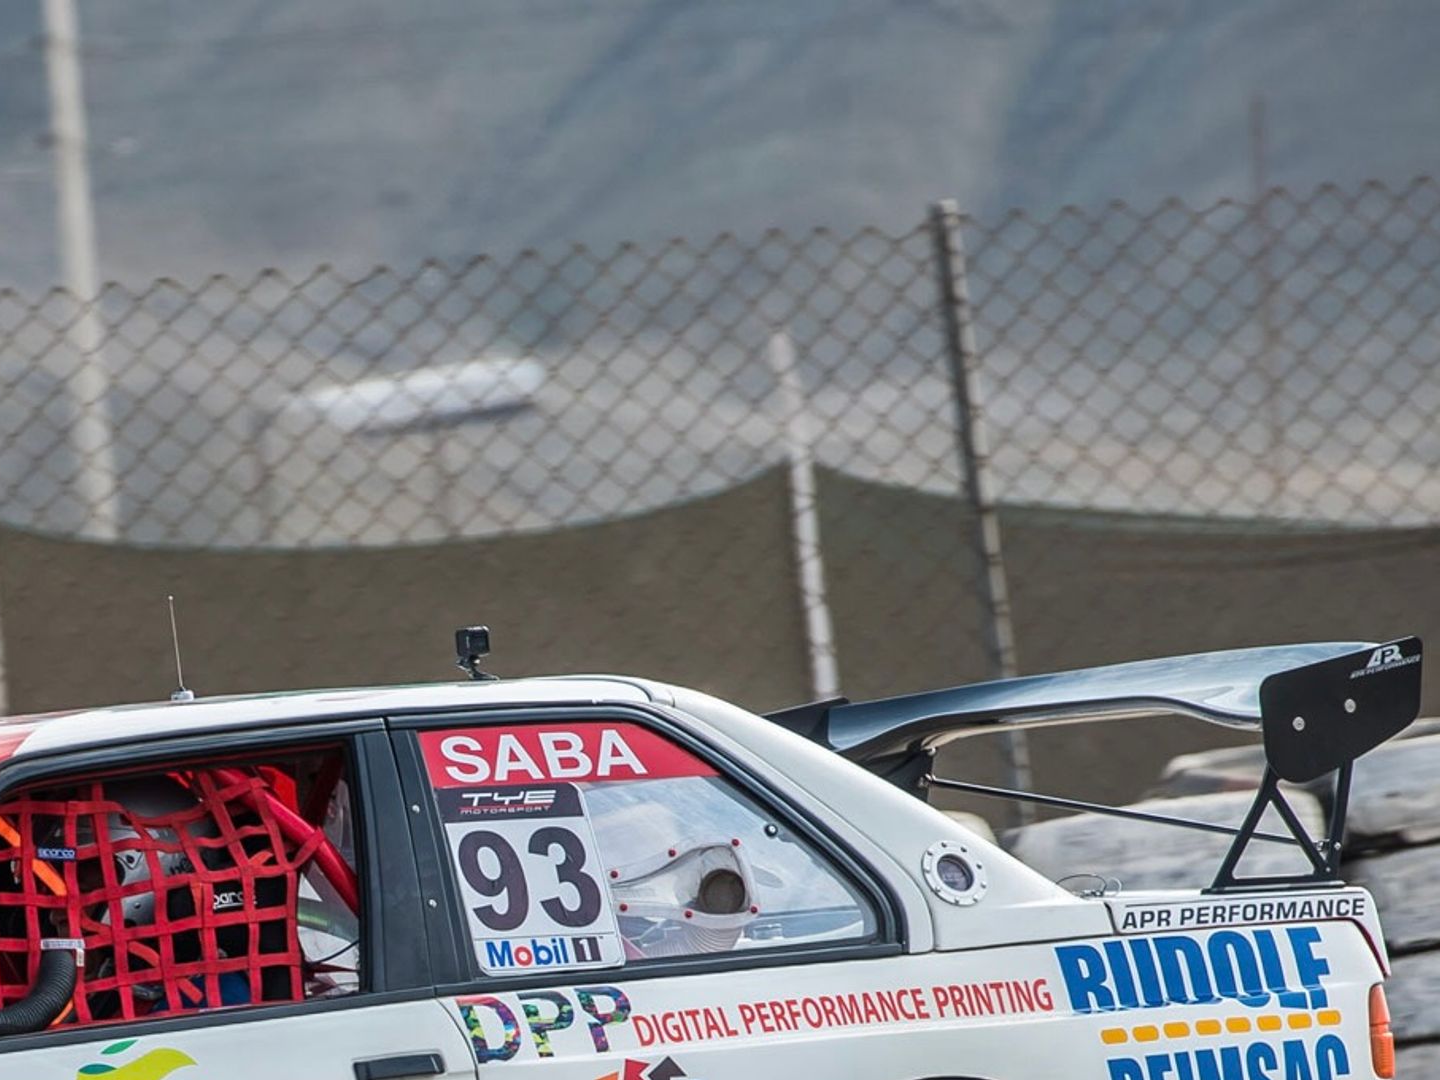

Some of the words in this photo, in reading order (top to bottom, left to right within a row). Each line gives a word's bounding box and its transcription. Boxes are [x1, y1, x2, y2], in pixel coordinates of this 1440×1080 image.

[440, 729, 648, 783] SABA
[460, 804, 550, 815] MOTORSPORT
[459, 826, 602, 931] 93
[1122, 911, 1171, 930] APR
[1179, 899, 1365, 926] PERFORMANCE
[485, 938, 568, 968] Mobil
[574, 937, 602, 964] 1
[1054, 926, 1330, 1015] RUDOLF
[457, 986, 632, 1064] DPP
[631, 1011, 738, 1047] DIGITAL
[737, 987, 931, 1036] PERFORMANCE
[932, 978, 1055, 1018] PRINTING
